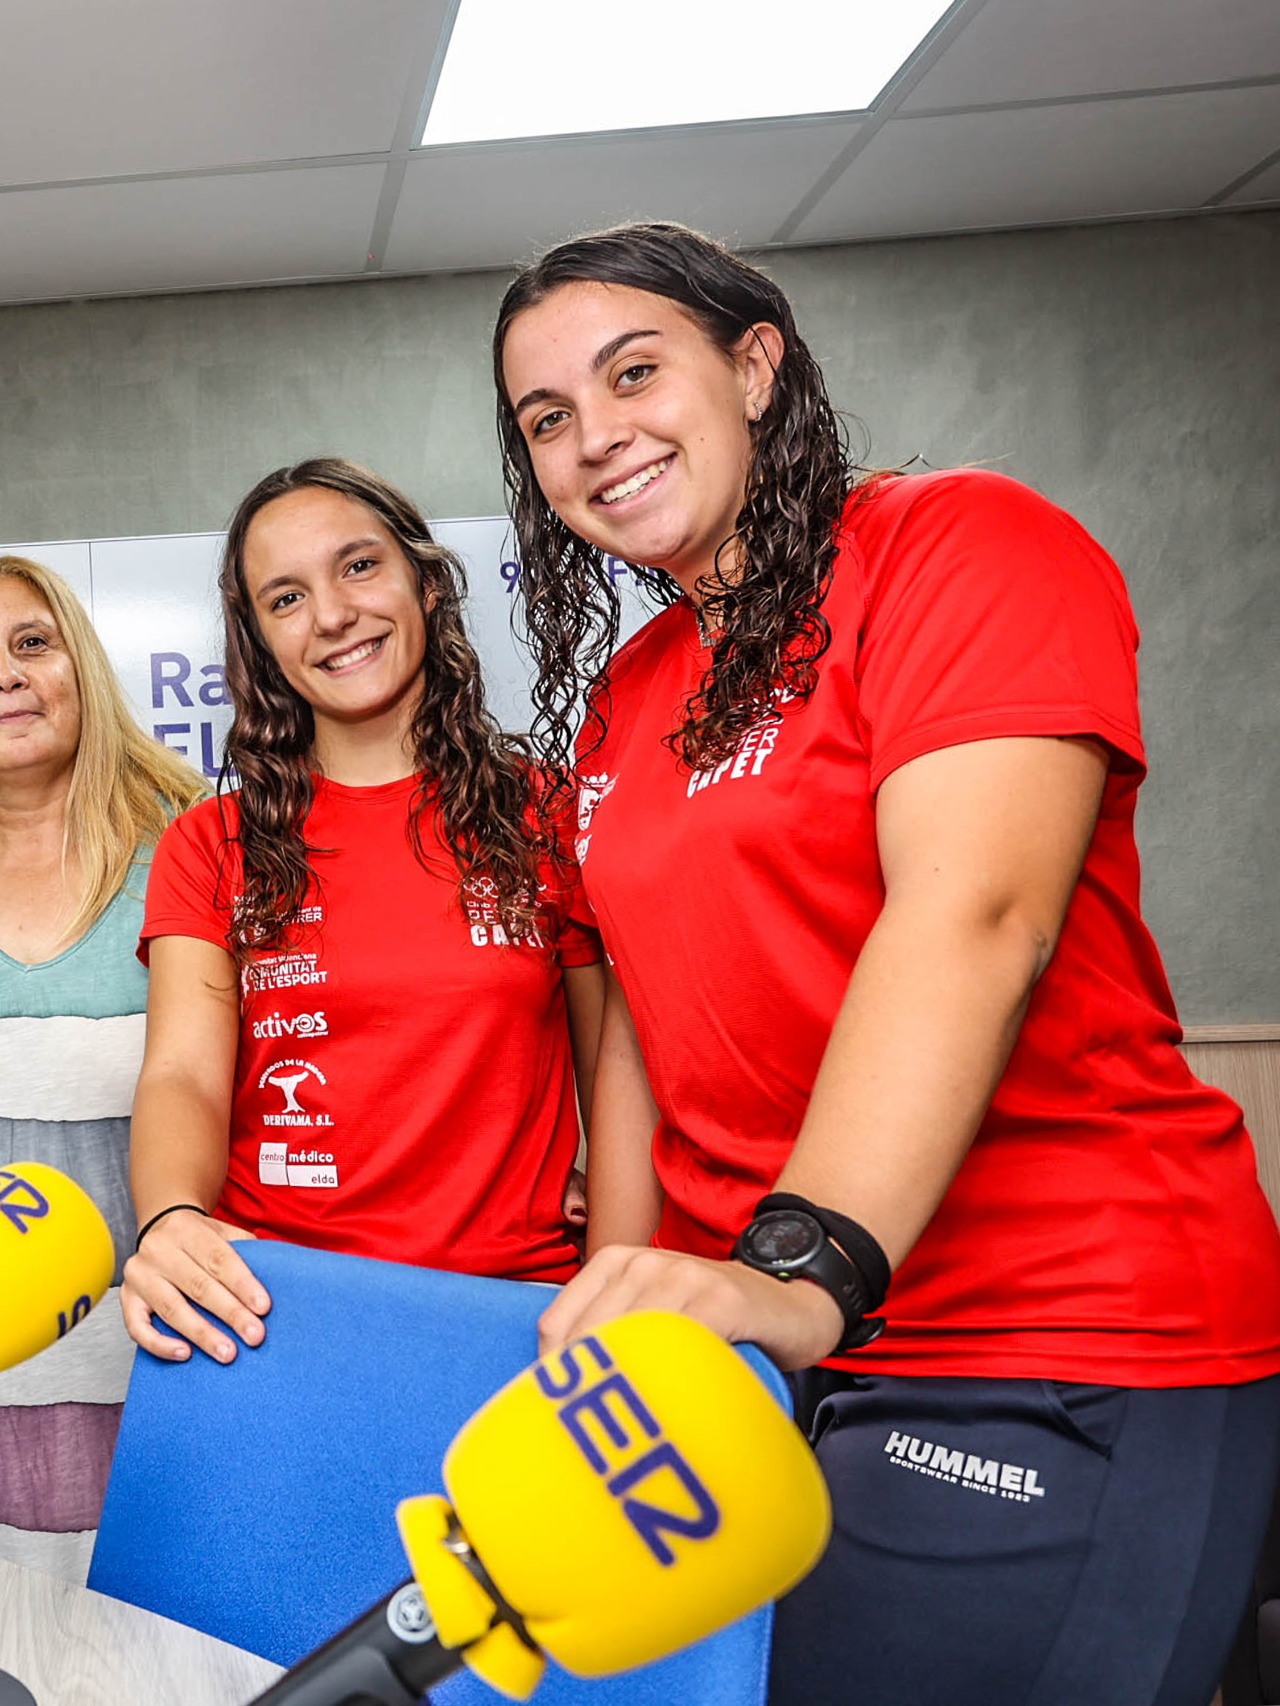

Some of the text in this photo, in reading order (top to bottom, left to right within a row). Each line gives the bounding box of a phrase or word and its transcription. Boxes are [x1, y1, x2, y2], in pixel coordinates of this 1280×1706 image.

[268, 971, 328, 989] L'ESPORT
[315, 1114, 335, 1126] S.L.
[260, 1149, 334, 1163] centro médico
[311, 1173, 335, 1184] elda
[534, 1336, 720, 1567] SER
[884, 1430, 1045, 1497] HUMMEL
[889, 1456, 958, 1484] SPORTSWEAR
[961, 1479, 997, 1495] SINCE
